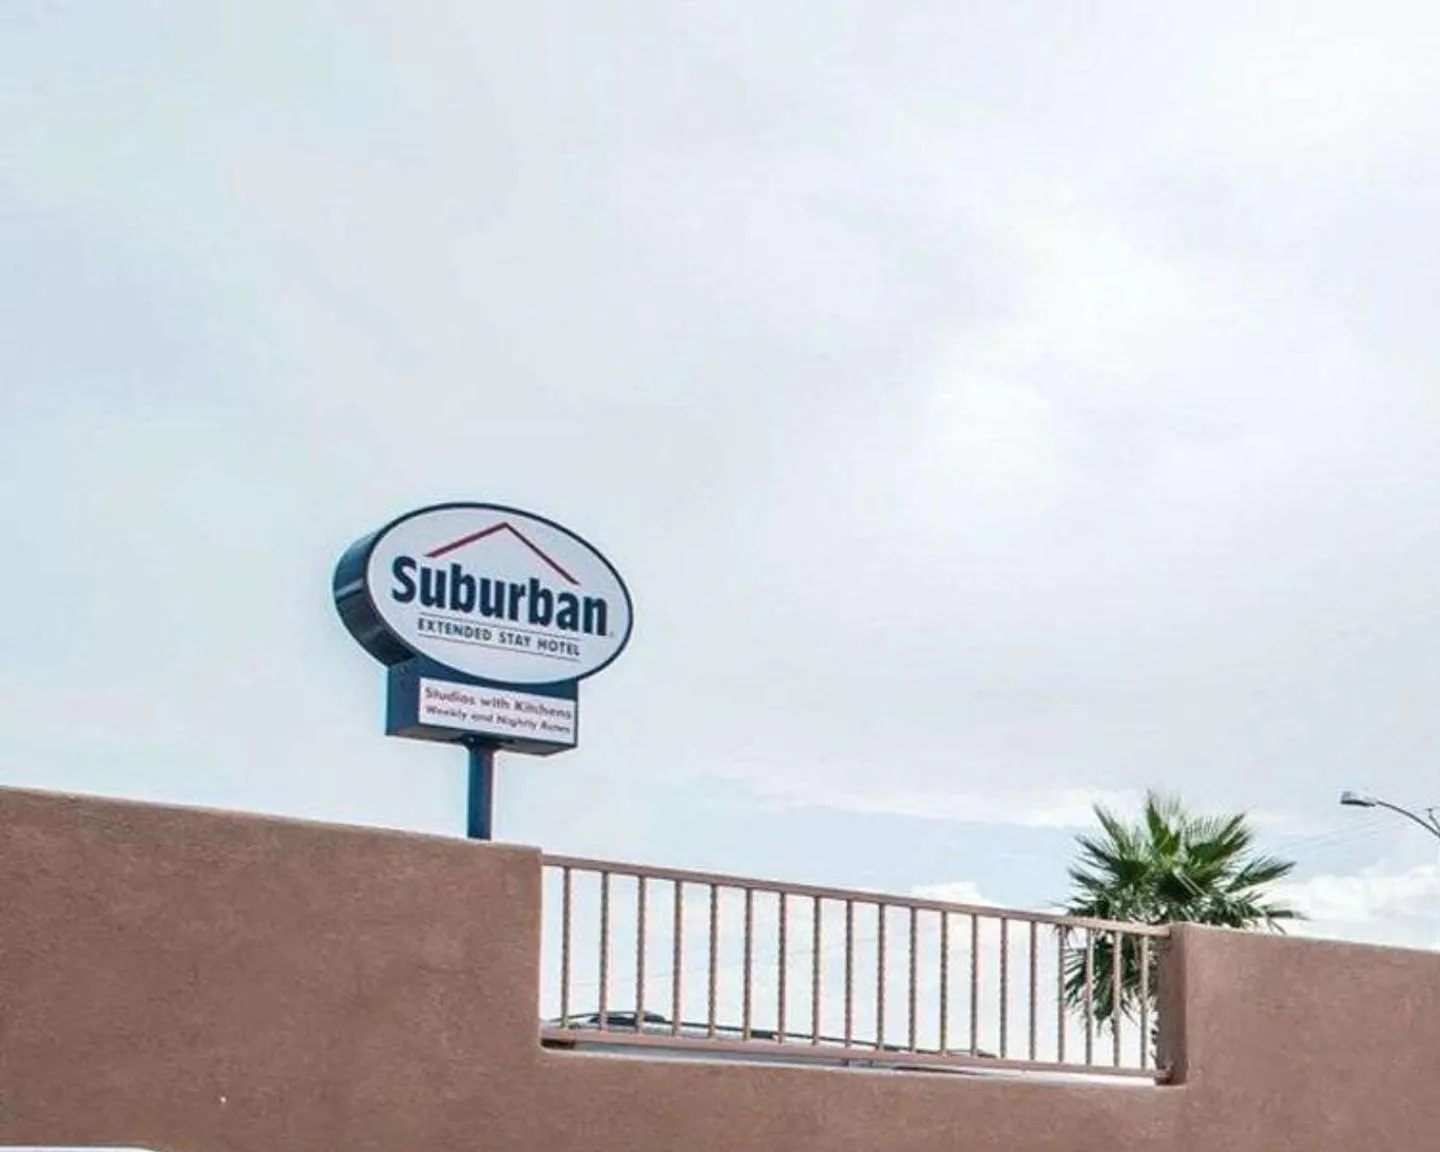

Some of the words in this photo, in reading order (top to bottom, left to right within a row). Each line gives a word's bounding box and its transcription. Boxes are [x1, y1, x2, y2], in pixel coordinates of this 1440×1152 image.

[391, 555, 608, 637] Suburban
[417, 617, 493, 642] EXTENDED
[498, 631, 532, 649] STAY
[536, 639, 581, 656] HOTEL
[424, 686, 476, 706] Studios
[480, 696, 511, 710] with
[514, 700, 572, 720] Kitchens
[424, 704, 467, 720] Weekly
[471, 711, 494, 724] and
